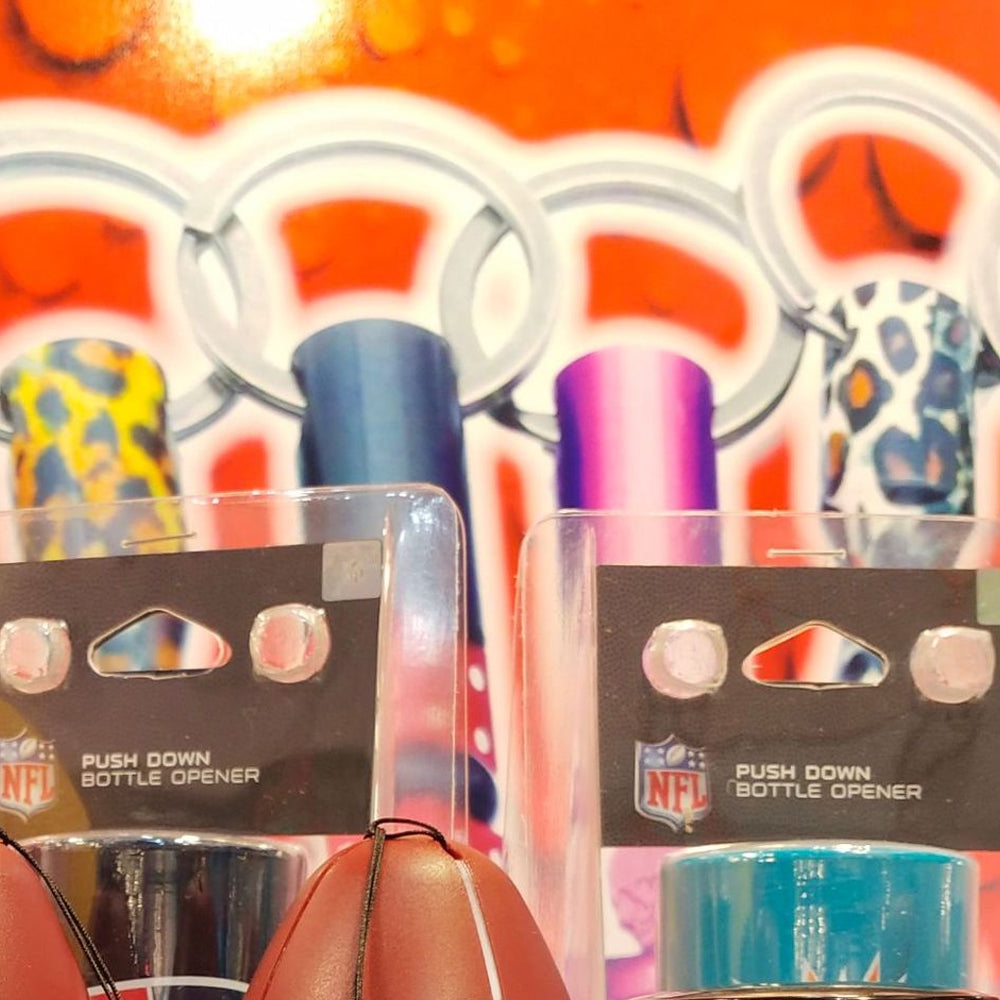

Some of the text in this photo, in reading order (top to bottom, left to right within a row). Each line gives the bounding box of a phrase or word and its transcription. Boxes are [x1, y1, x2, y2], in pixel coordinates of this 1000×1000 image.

[81, 751, 211, 770] PUSH DOWN
[81, 767, 260, 788] BOTTLE OPENER
[735, 763, 871, 781] PUSH DOWN
[2, 764, 55, 805] NFL
[647, 770, 707, 813] NFL
[735, 781, 922, 800] BOTTLE OPENER
